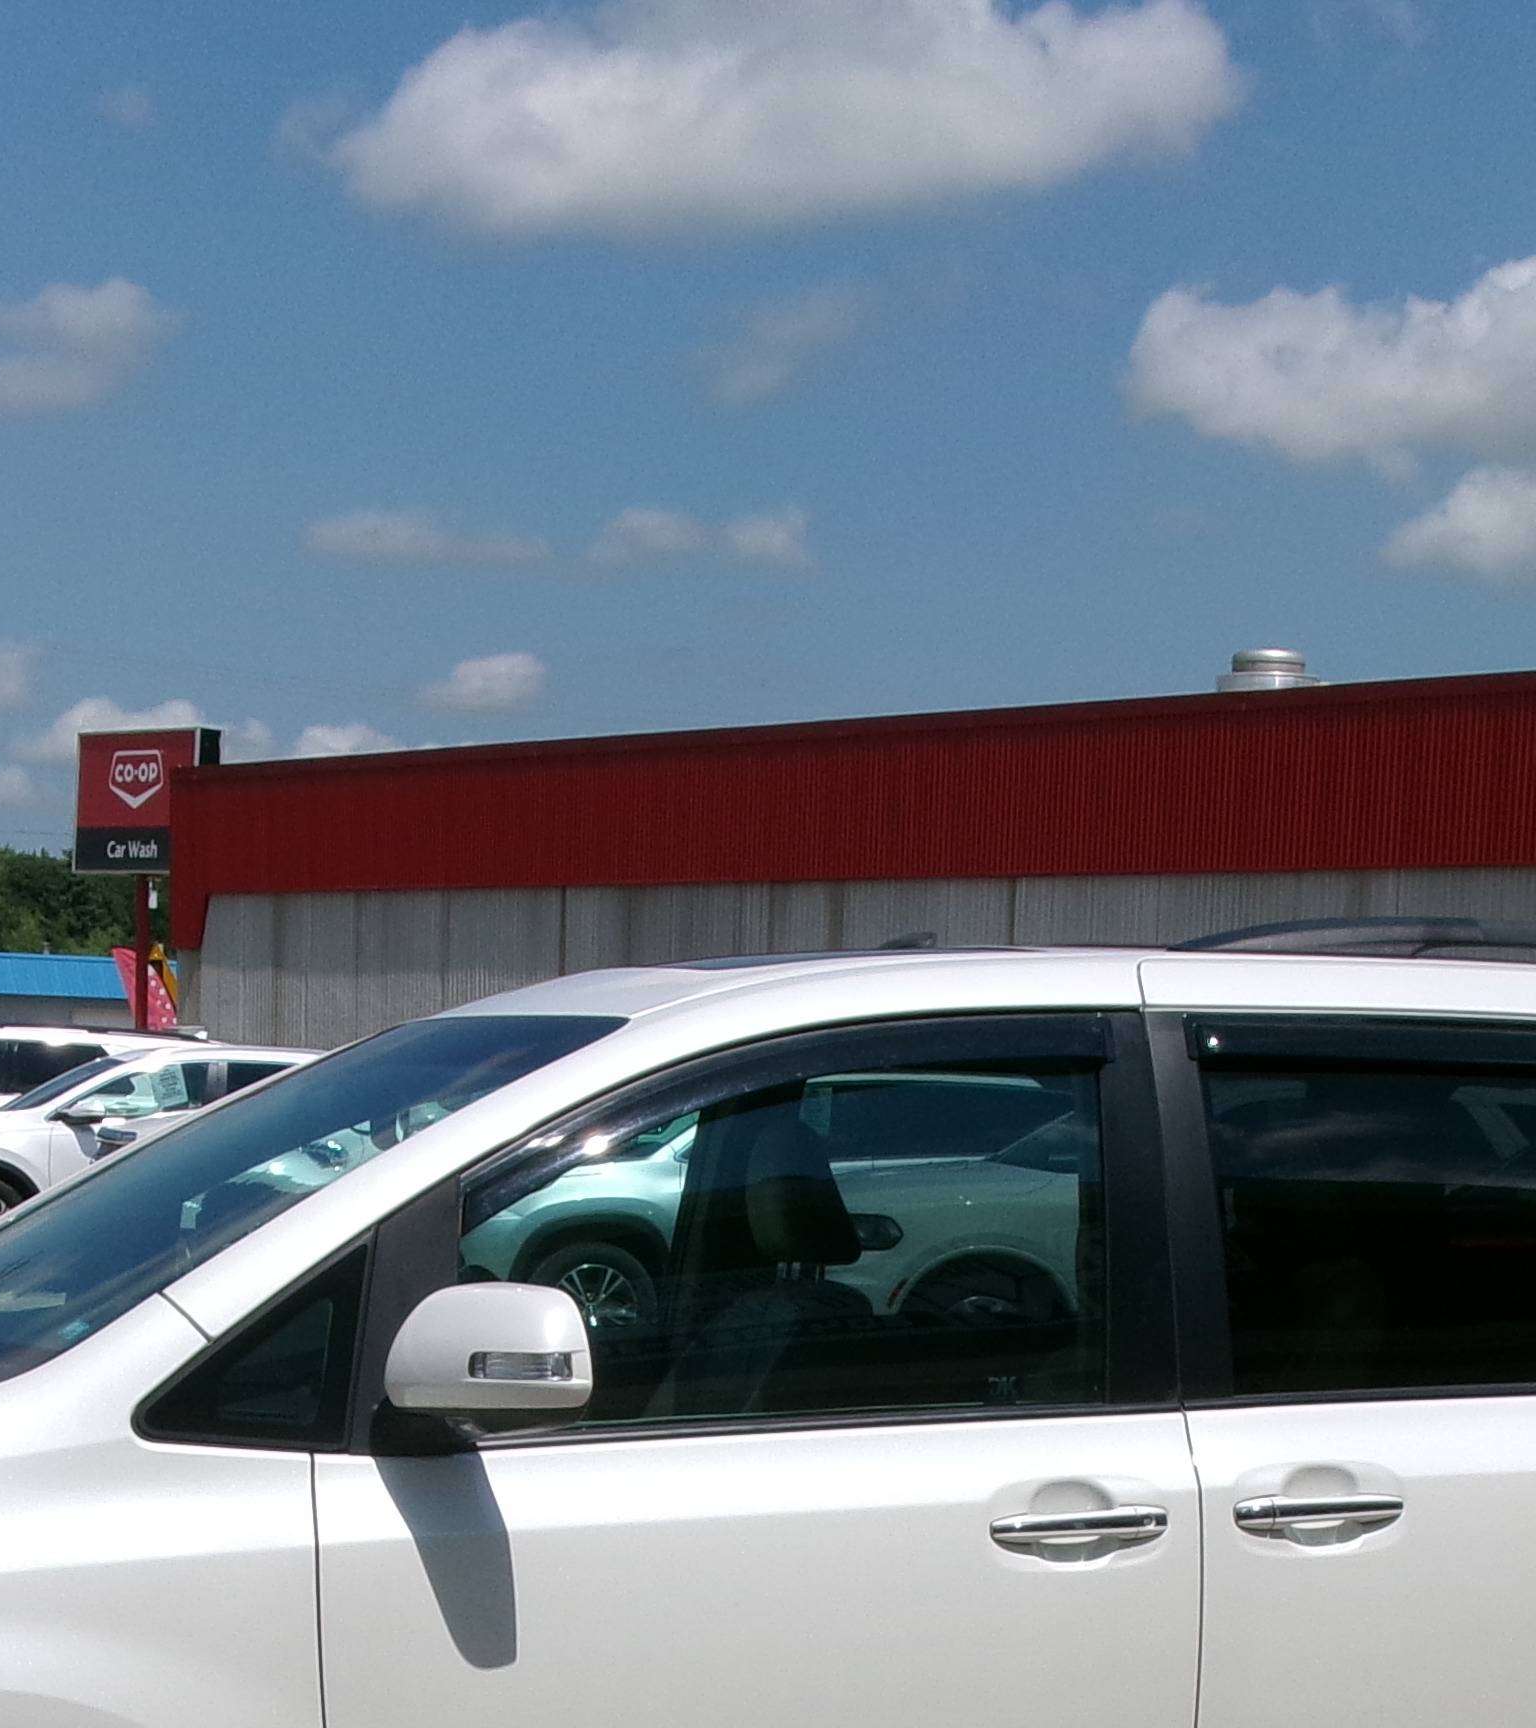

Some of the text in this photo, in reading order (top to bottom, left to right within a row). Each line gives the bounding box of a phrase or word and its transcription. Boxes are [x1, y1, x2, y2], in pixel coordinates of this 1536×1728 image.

[114, 762, 158, 783] CO-OP
[106, 838, 158, 859] Car Wash
